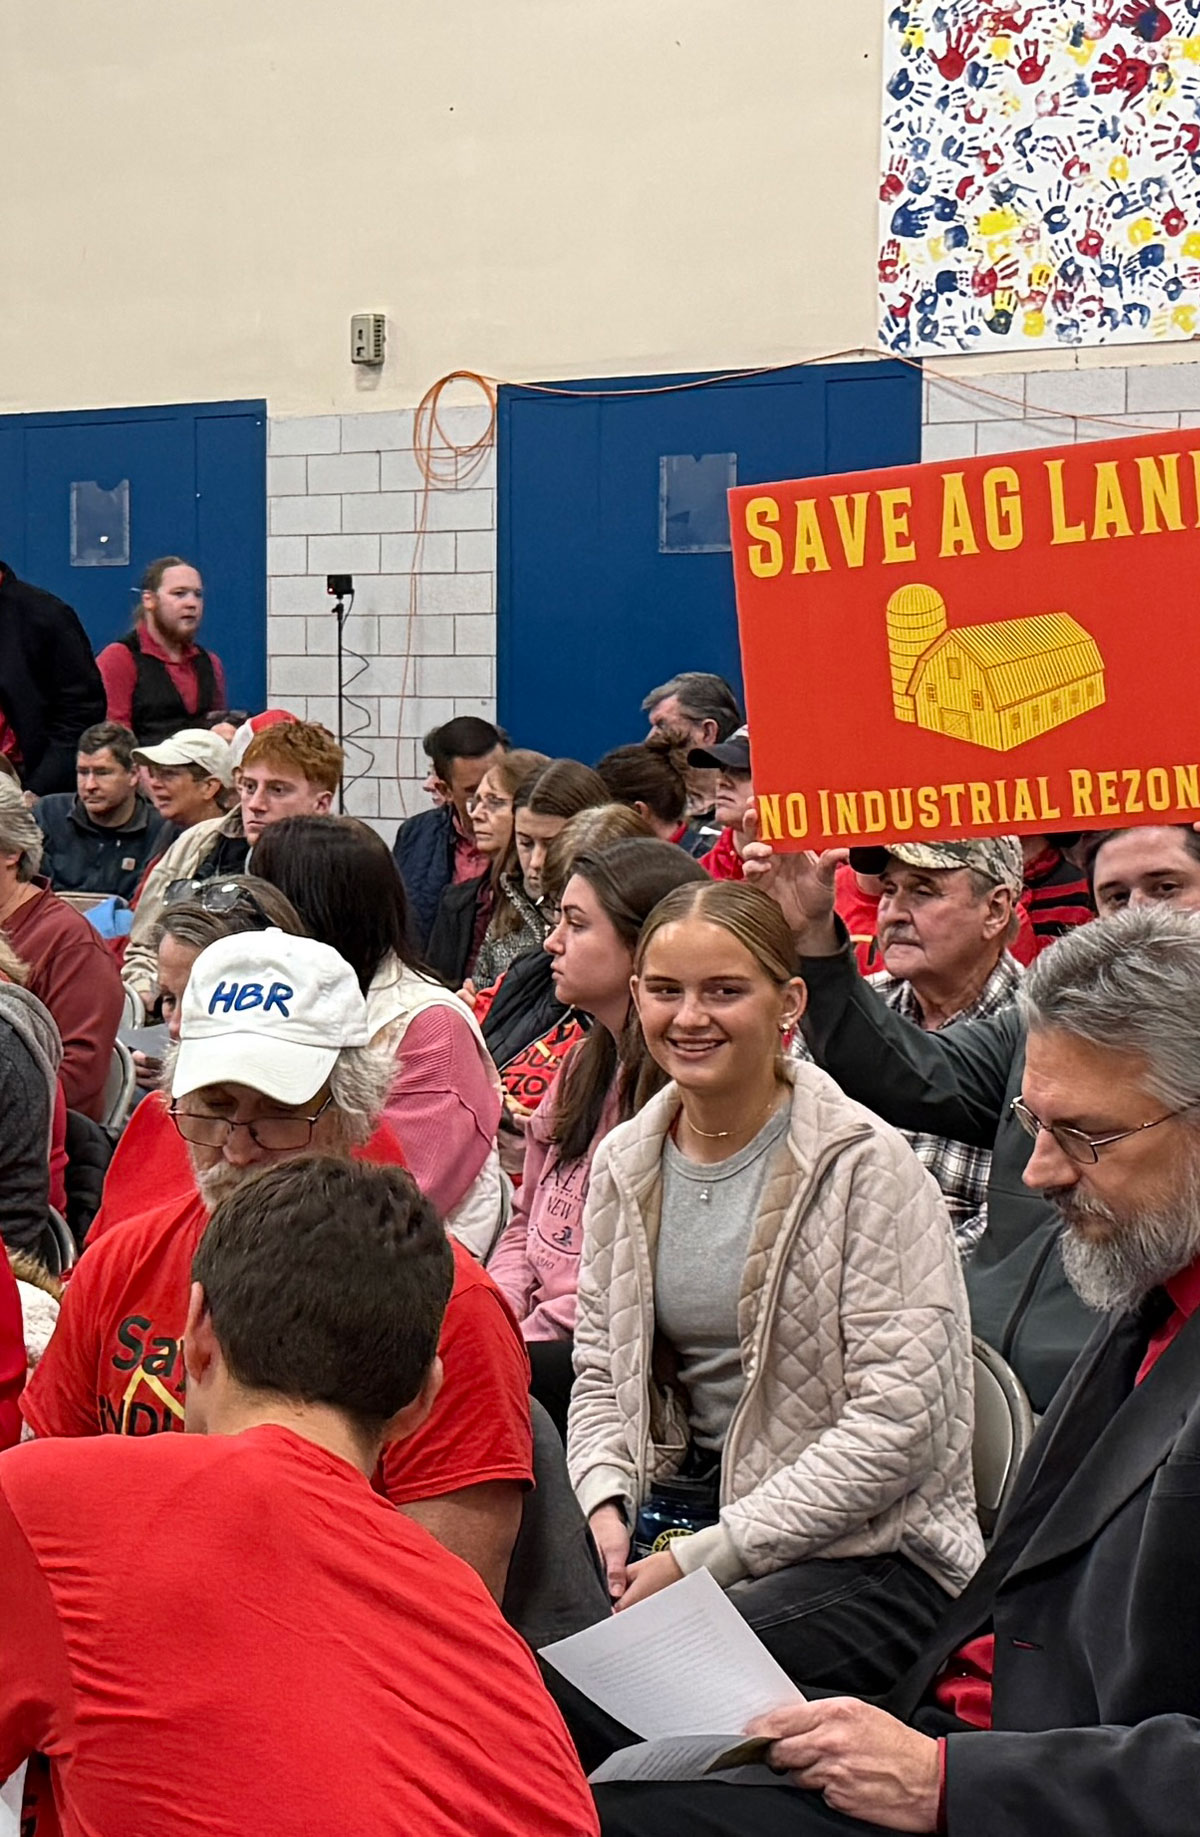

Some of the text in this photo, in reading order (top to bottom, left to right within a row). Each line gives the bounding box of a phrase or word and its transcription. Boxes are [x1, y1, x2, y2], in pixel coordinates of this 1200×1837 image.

[745, 486, 917, 579] SAVE
[938, 466, 1024, 558] AG
[757, 792, 808, 841] NO
[817, 776, 1061, 837] INDUSTRIAL
[208, 981, 294, 1018] HBR
[112, 1315, 184, 1393] Sa
